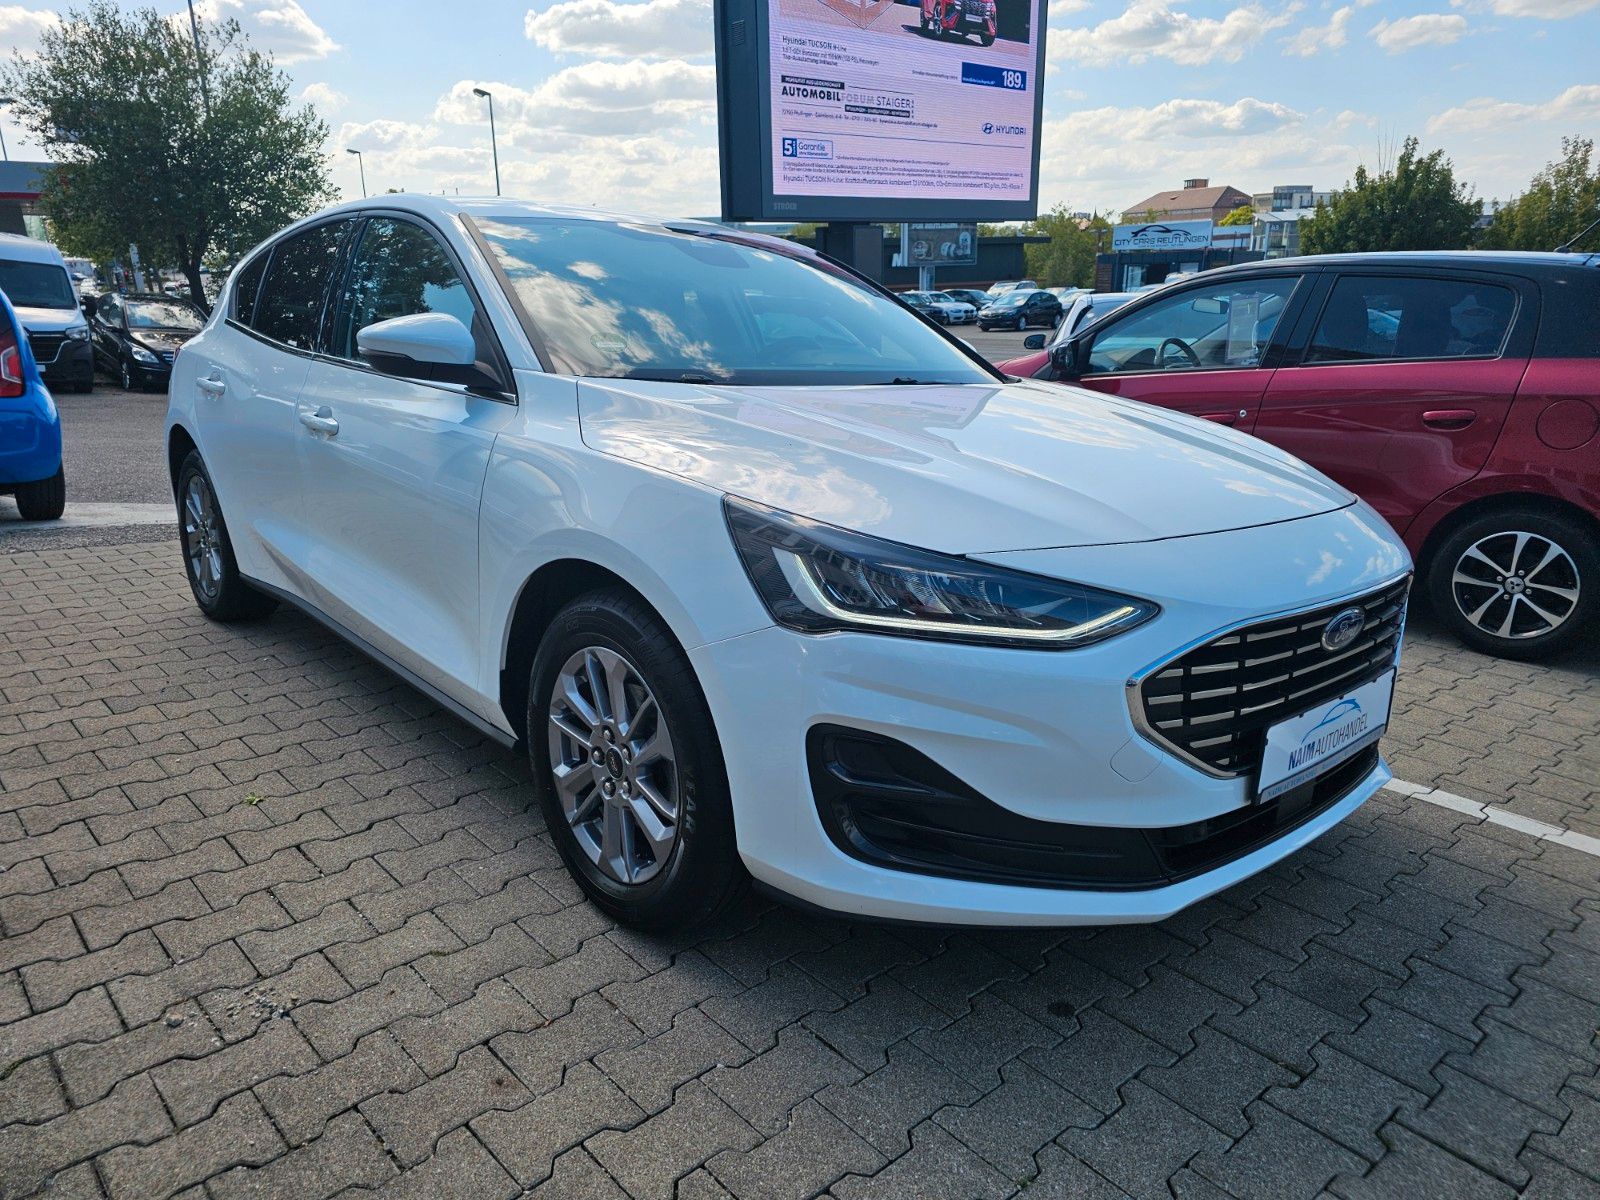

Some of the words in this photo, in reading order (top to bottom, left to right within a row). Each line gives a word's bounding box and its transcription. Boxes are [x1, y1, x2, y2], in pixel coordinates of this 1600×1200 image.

[782, 36, 808, 46] Hyundai
[808, 40, 832, 50] TUCSON
[876, 96, 910, 108] STAIGER
[995, 124, 1027, 135] HYUNDAI
[783, 139, 793, 156] 5
[798, 142, 826, 152] Garantie
[783, 174, 804, 184] Hyundai
[805, 175, 827, 183] TUCSON
[1133, 237, 1155, 245] CARS
[1156, 235, 1209, 244] REUTLINGEN
